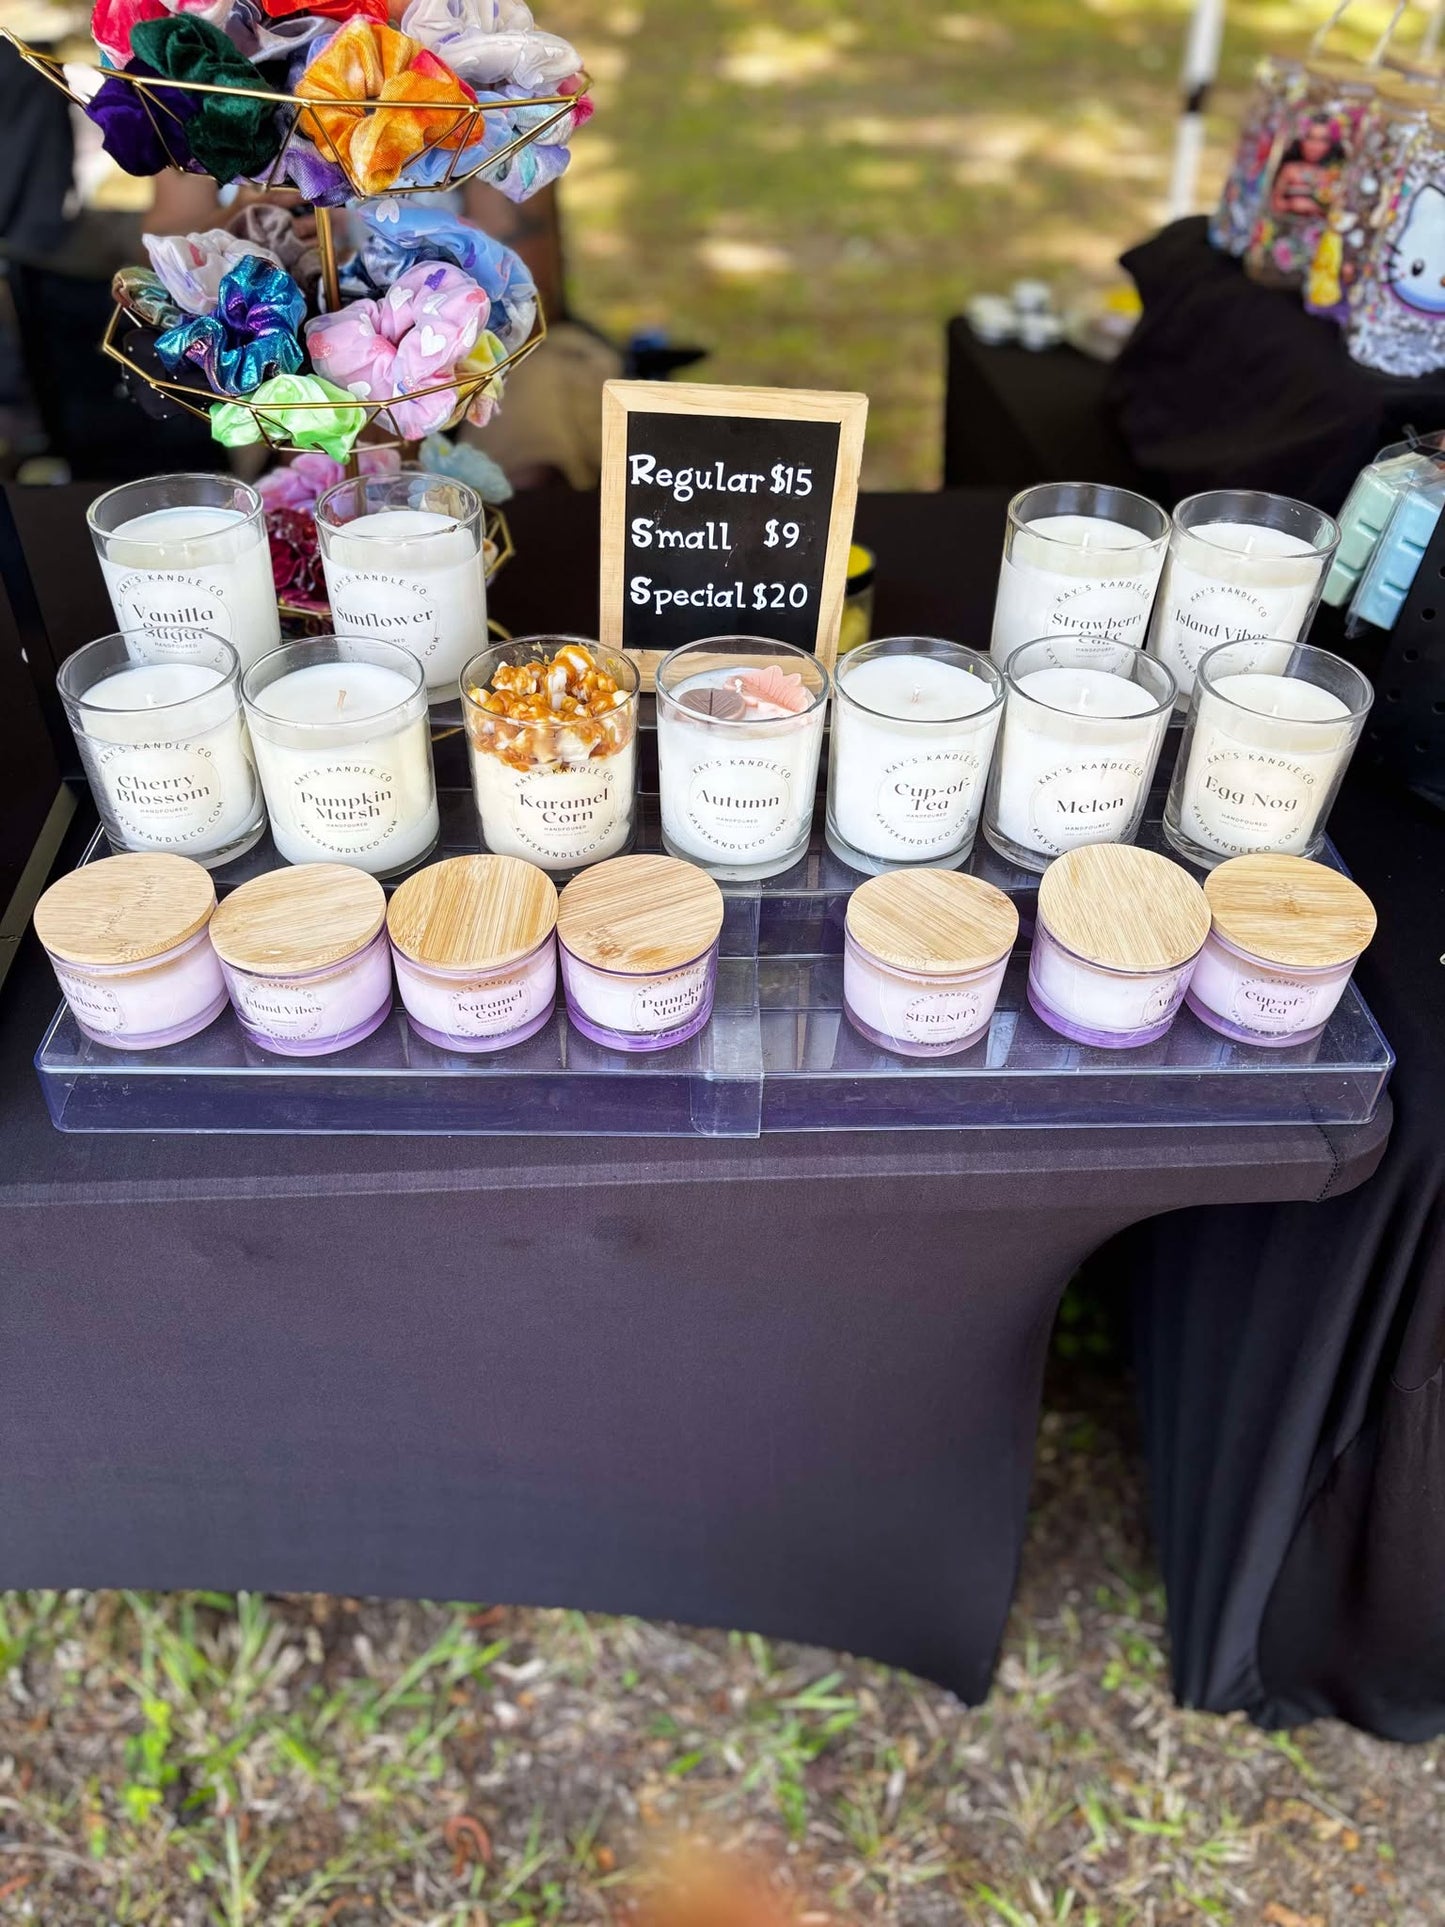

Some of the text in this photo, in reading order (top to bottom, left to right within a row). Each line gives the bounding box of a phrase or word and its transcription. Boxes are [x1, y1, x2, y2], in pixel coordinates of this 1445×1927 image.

[629, 454, 812, 502] Regular $15
[631, 518, 800, 550] Small $9
[148, 574, 202, 586] KANDLE
[356, 574, 405, 586] KANDLE
[1100, 581, 1142, 590] KANDLE
[630, 576, 808, 614] Special $20
[1221, 586, 1258, 604] KANDLE
[133, 603, 214, 624] Vanilla
[336, 607, 433, 628] Sunflower
[1176, 609, 1269, 645] Island Vibes
[133, 742, 191, 751] KANDLE
[730, 760, 778, 770] KANDLE
[926, 754, 970, 762] KANDLE
[1082, 762, 1132, 771] KANDLE
[1248, 754, 1301, 774] KANDLE
[326, 766, 376, 776] KANDLE
[552, 766, 600, 775] KANDLE
[118, 774, 194, 790] Cherry
[116, 786, 210, 805] Blossom
[301, 790, 392, 809] Pumpkin
[520, 788, 608, 810] Karamel
[697, 789, 780, 808] Autumn
[1205, 775, 1298, 812] Egg Nog
[316, 806, 380, 820] Marsh
[911, 799, 949, 811] Tea
[1056, 798, 1124, 814] Melon
[542, 810, 593, 824] Corn
[458, 989, 523, 1012] Karamel
[642, 980, 707, 1008] Pumpkin
[245, 996, 322, 1015] Island Vibes
[475, 1005, 513, 1020] Corn
[653, 995, 699, 1017] Marsh
[1258, 1003, 1287, 1014] Tea
[906, 1008, 976, 1023] SERENITY
